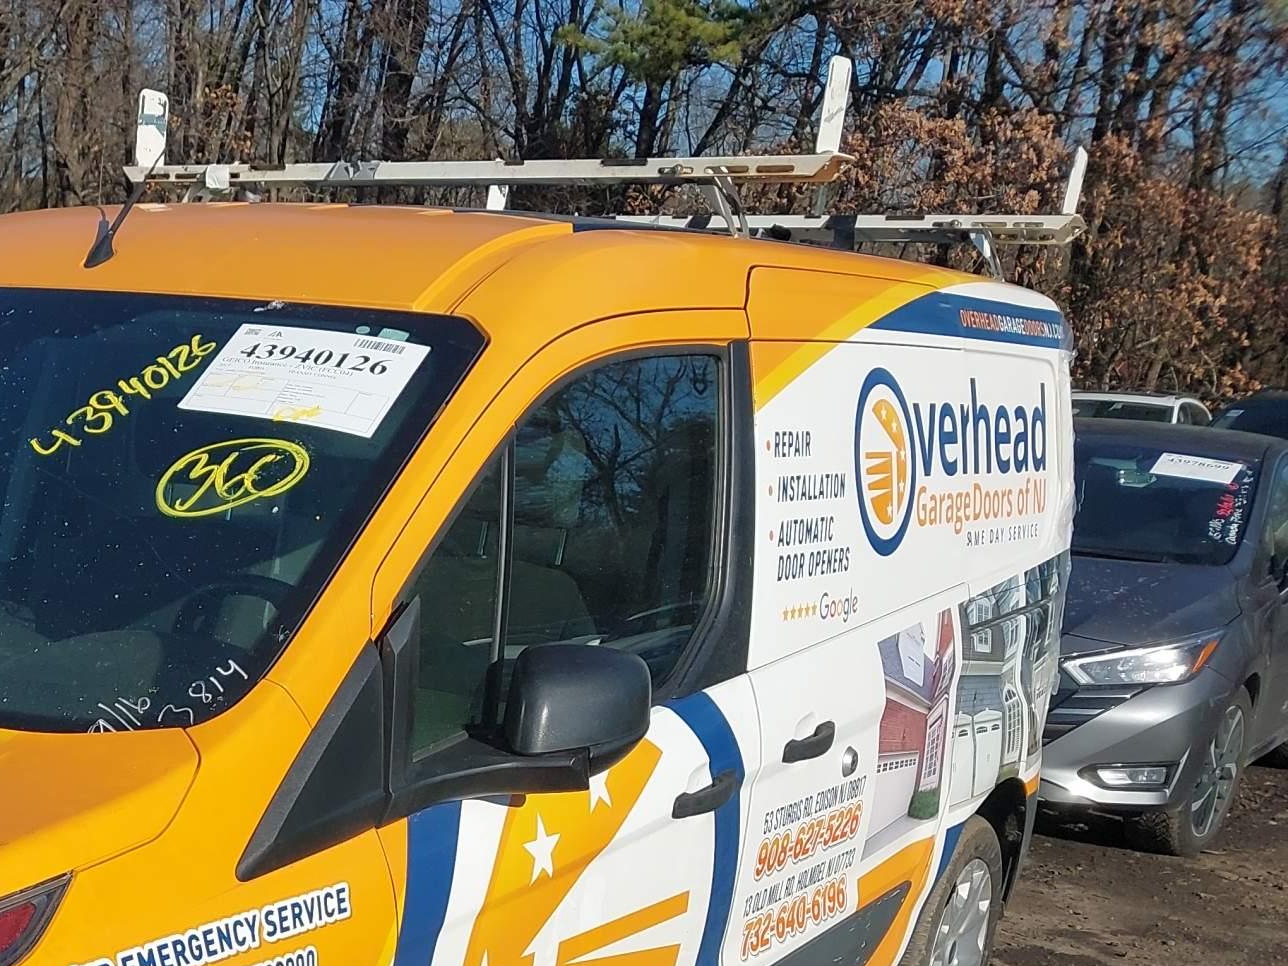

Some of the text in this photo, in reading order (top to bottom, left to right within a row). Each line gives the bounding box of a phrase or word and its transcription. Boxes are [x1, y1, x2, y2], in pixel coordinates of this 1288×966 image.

[240, 342, 393, 376] 43940126
[30, 335, 217, 456] 43940126
[774, 431, 811, 458] REPAIR
[777, 473, 846, 503] INSTALLATION
[1017, 478, 1031, 516] of
[1033, 478, 1047, 514] NJ
[777, 515, 834, 547] AUTOMATIC
[989, 528, 1004, 545] DAY
[1008, 523, 1038, 541] SERVICE
[777, 546, 850, 582] DOOR OPENERS
[819, 587, 858, 623] Google
[763, 811, 774, 835] 53
[815, 785, 839, 814] EDISON
[755, 803, 862, 878] 908-627-5226
[263, 887, 349, 938] SERVICE
[741, 875, 846, 959] 732-640-6196
[743, 895, 753, 917] 13
[752, 888, 768, 914] OLD
[767, 881, 784, 906] MILL
